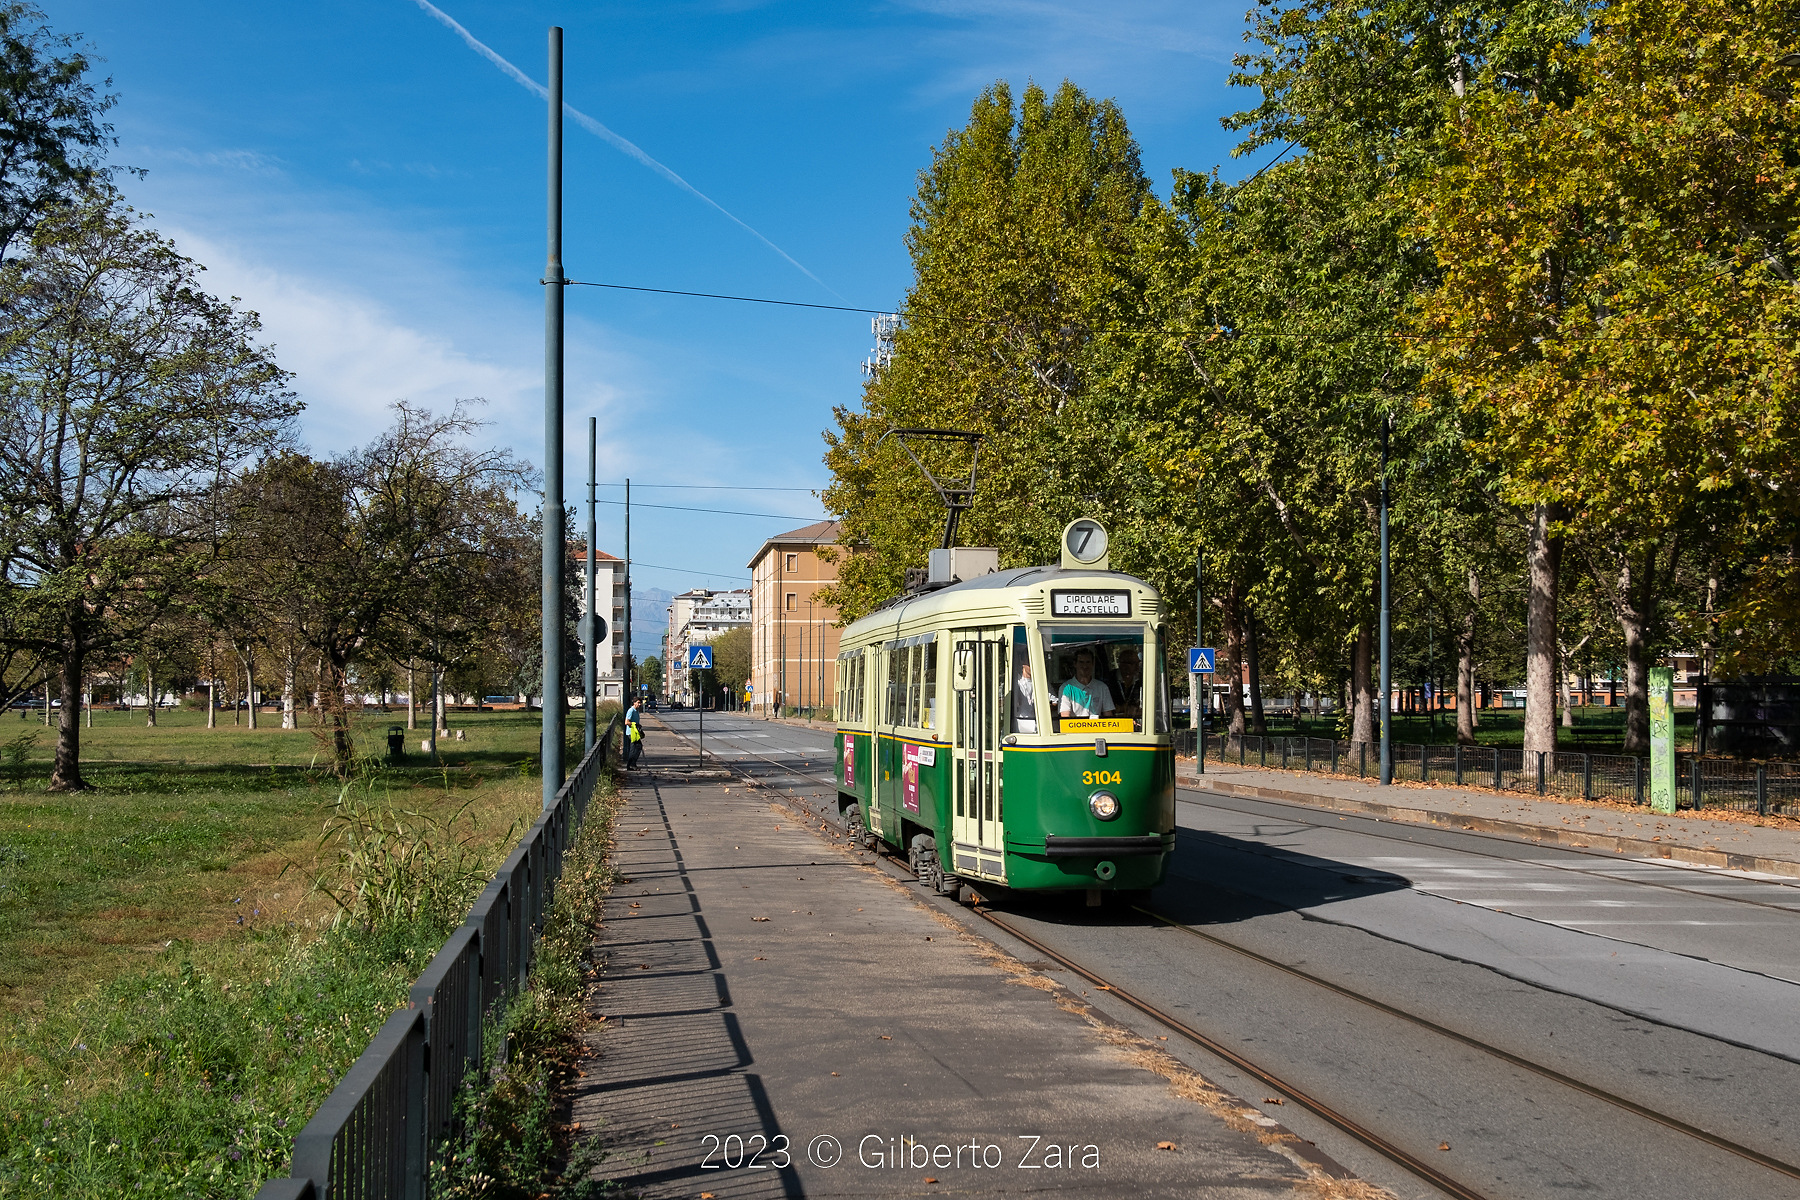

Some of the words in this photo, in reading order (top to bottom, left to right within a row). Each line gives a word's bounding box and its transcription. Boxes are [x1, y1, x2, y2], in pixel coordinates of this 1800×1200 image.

[1076, 527, 1094, 554] 7
[1066, 595, 1115, 604] CIRCOLARE
[1063, 605, 1072, 613] P.
[1074, 605, 1119, 614] CASTELLO
[1082, 770, 1122, 785] 3104
